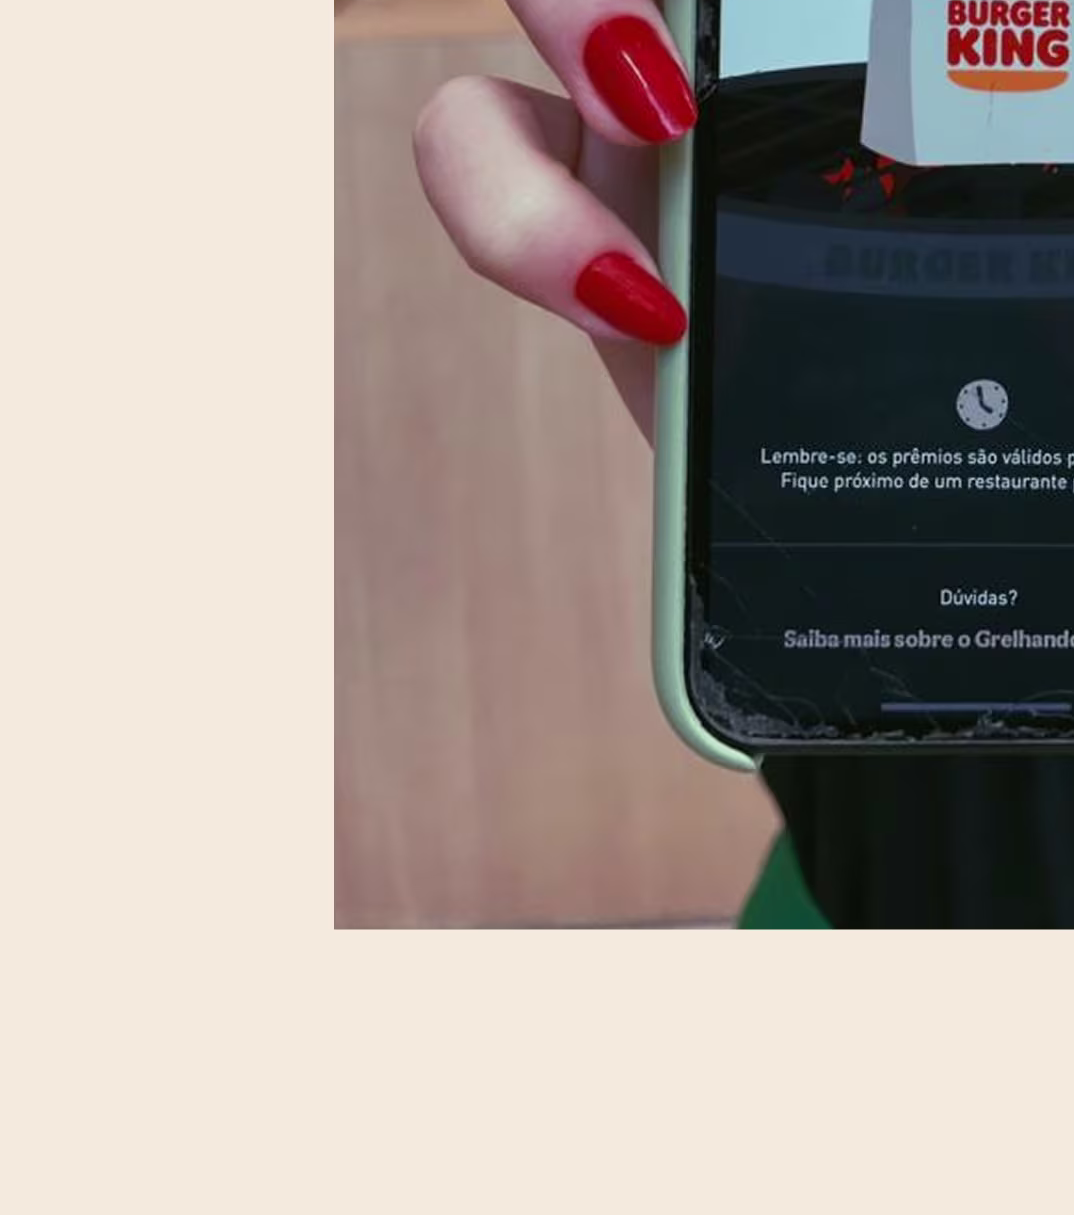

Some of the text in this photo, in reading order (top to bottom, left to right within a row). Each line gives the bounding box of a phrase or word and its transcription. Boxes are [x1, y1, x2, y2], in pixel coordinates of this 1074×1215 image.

[947, 27, 1071, 68] KING
[760, 447, 863, 466] Lembre-se:
[867, 451, 888, 466] os
[892, 447, 963, 469] prêmios
[967, 448, 998, 466] são
[1001, 448, 1063, 467] válidos
[780, 471, 830, 494] Fique
[833, 471, 905, 494] próximo
[908, 472, 931, 490] de
[934, 476, 963, 490] um
[967, 474, 1068, 491] restaurante
[940, 588, 1018, 607] Dúvidas?
[784, 629, 841, 649] Saiba
[843, 629, 891, 649] mais
[894, 629, 954, 649] sobre
[957, 634, 971, 649] o
